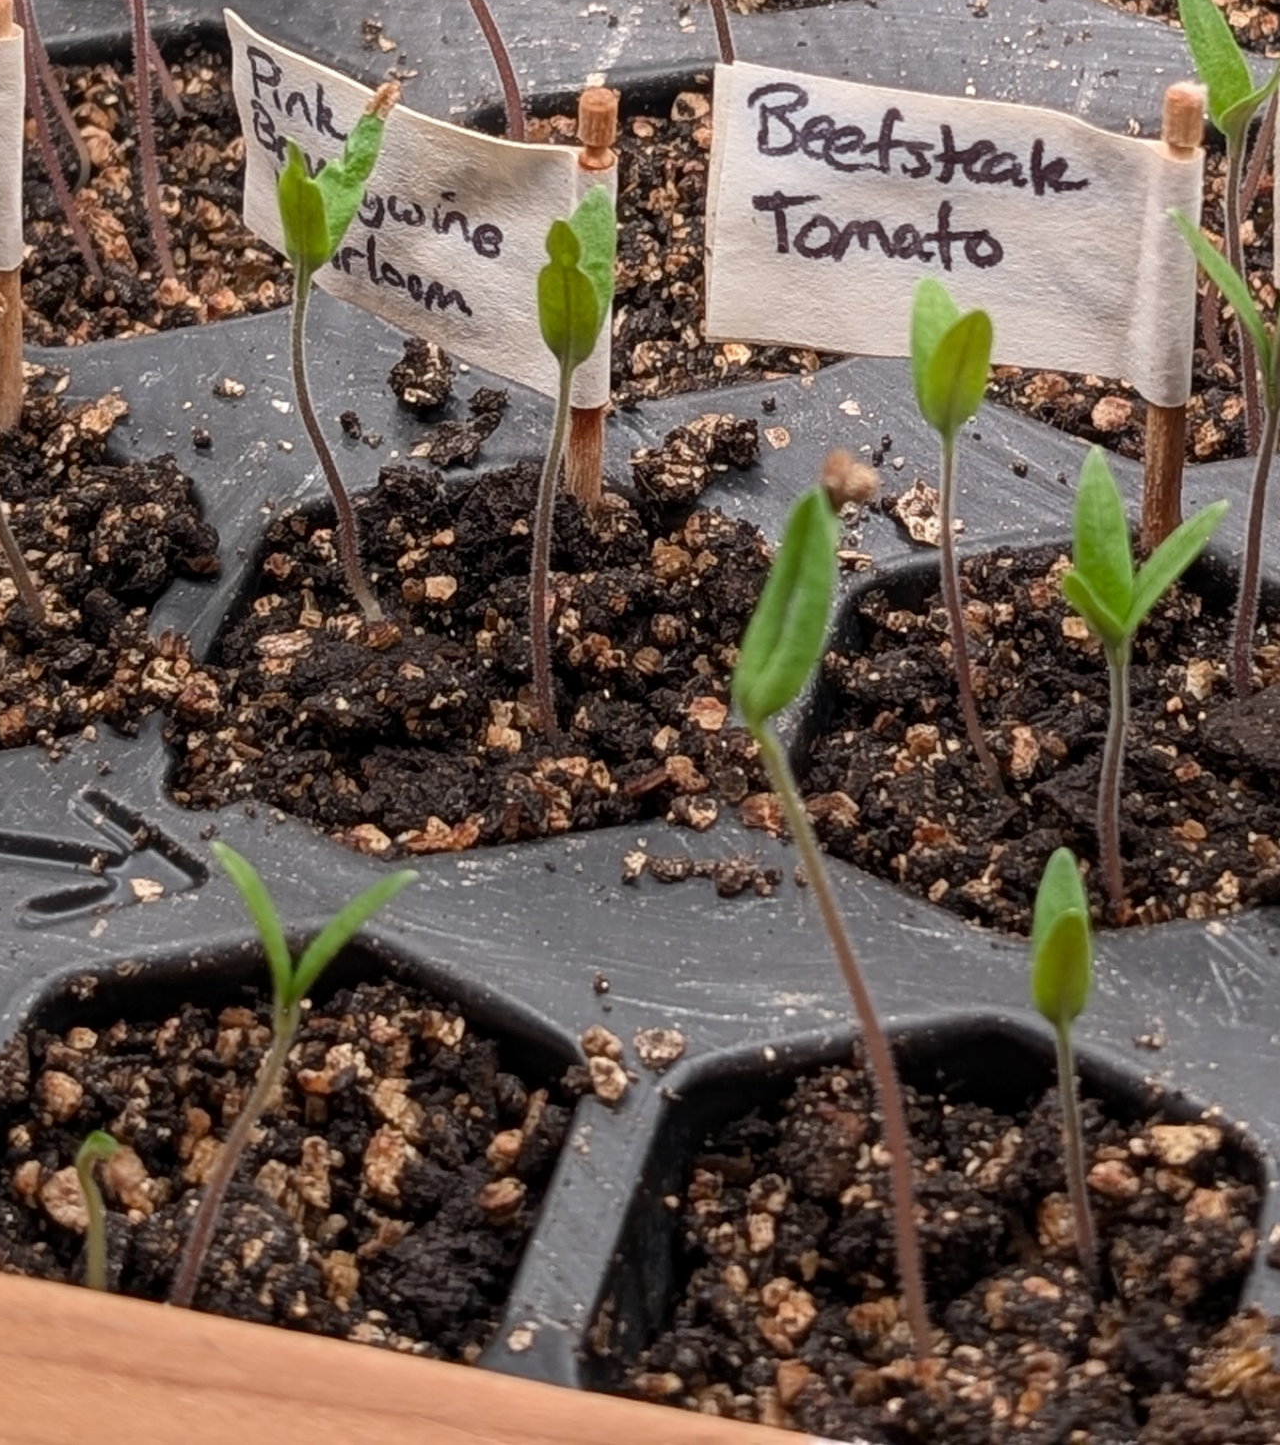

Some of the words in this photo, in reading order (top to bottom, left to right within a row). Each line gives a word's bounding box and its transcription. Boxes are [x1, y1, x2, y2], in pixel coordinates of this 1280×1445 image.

[247, 44, 348, 142] Pink
[748, 82, 1091, 197] Beefsteak
[751, 189, 1005, 272] Tomato
